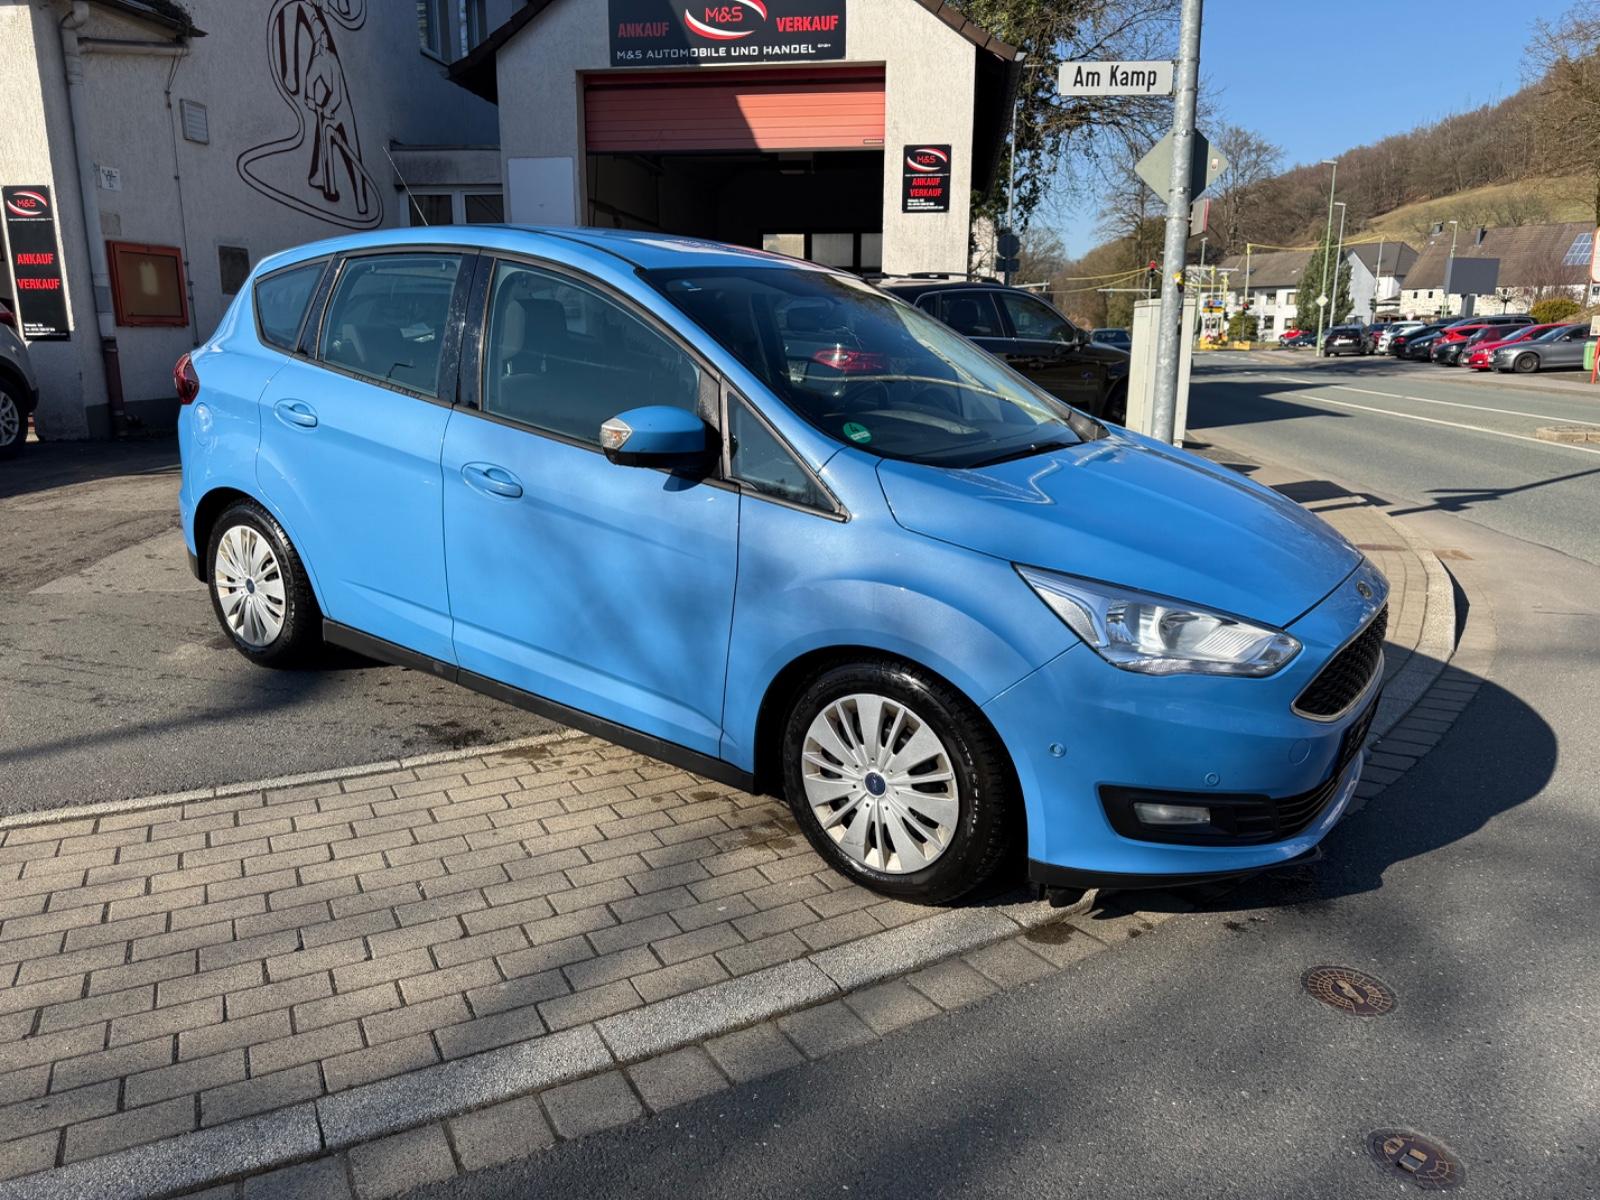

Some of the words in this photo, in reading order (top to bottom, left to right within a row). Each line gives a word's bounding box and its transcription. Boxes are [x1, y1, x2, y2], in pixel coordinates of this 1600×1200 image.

[705, 6, 744, 23] M&S
[618, 22, 670, 38] ANKAUF
[776, 15, 839, 33] VERKAUF
[616, 49, 643, 60] M&S
[646, 47, 727, 58] AUTOMOBILE
[731, 46, 759, 56] UND
[763, 44, 816, 55] HANDEL
[1073, 65, 1100, 87] Am
[1109, 65, 1157, 92] Kamp
[917, 155, 936, 164] M&S
[912, 177, 941, 186] ANKAUF
[910, 188, 942, 197] VERKAUF
[16, 199, 37, 208] M&S
[17, 253, 54, 265] ANKAUF
[17, 278, 60, 290] VERKAUF
